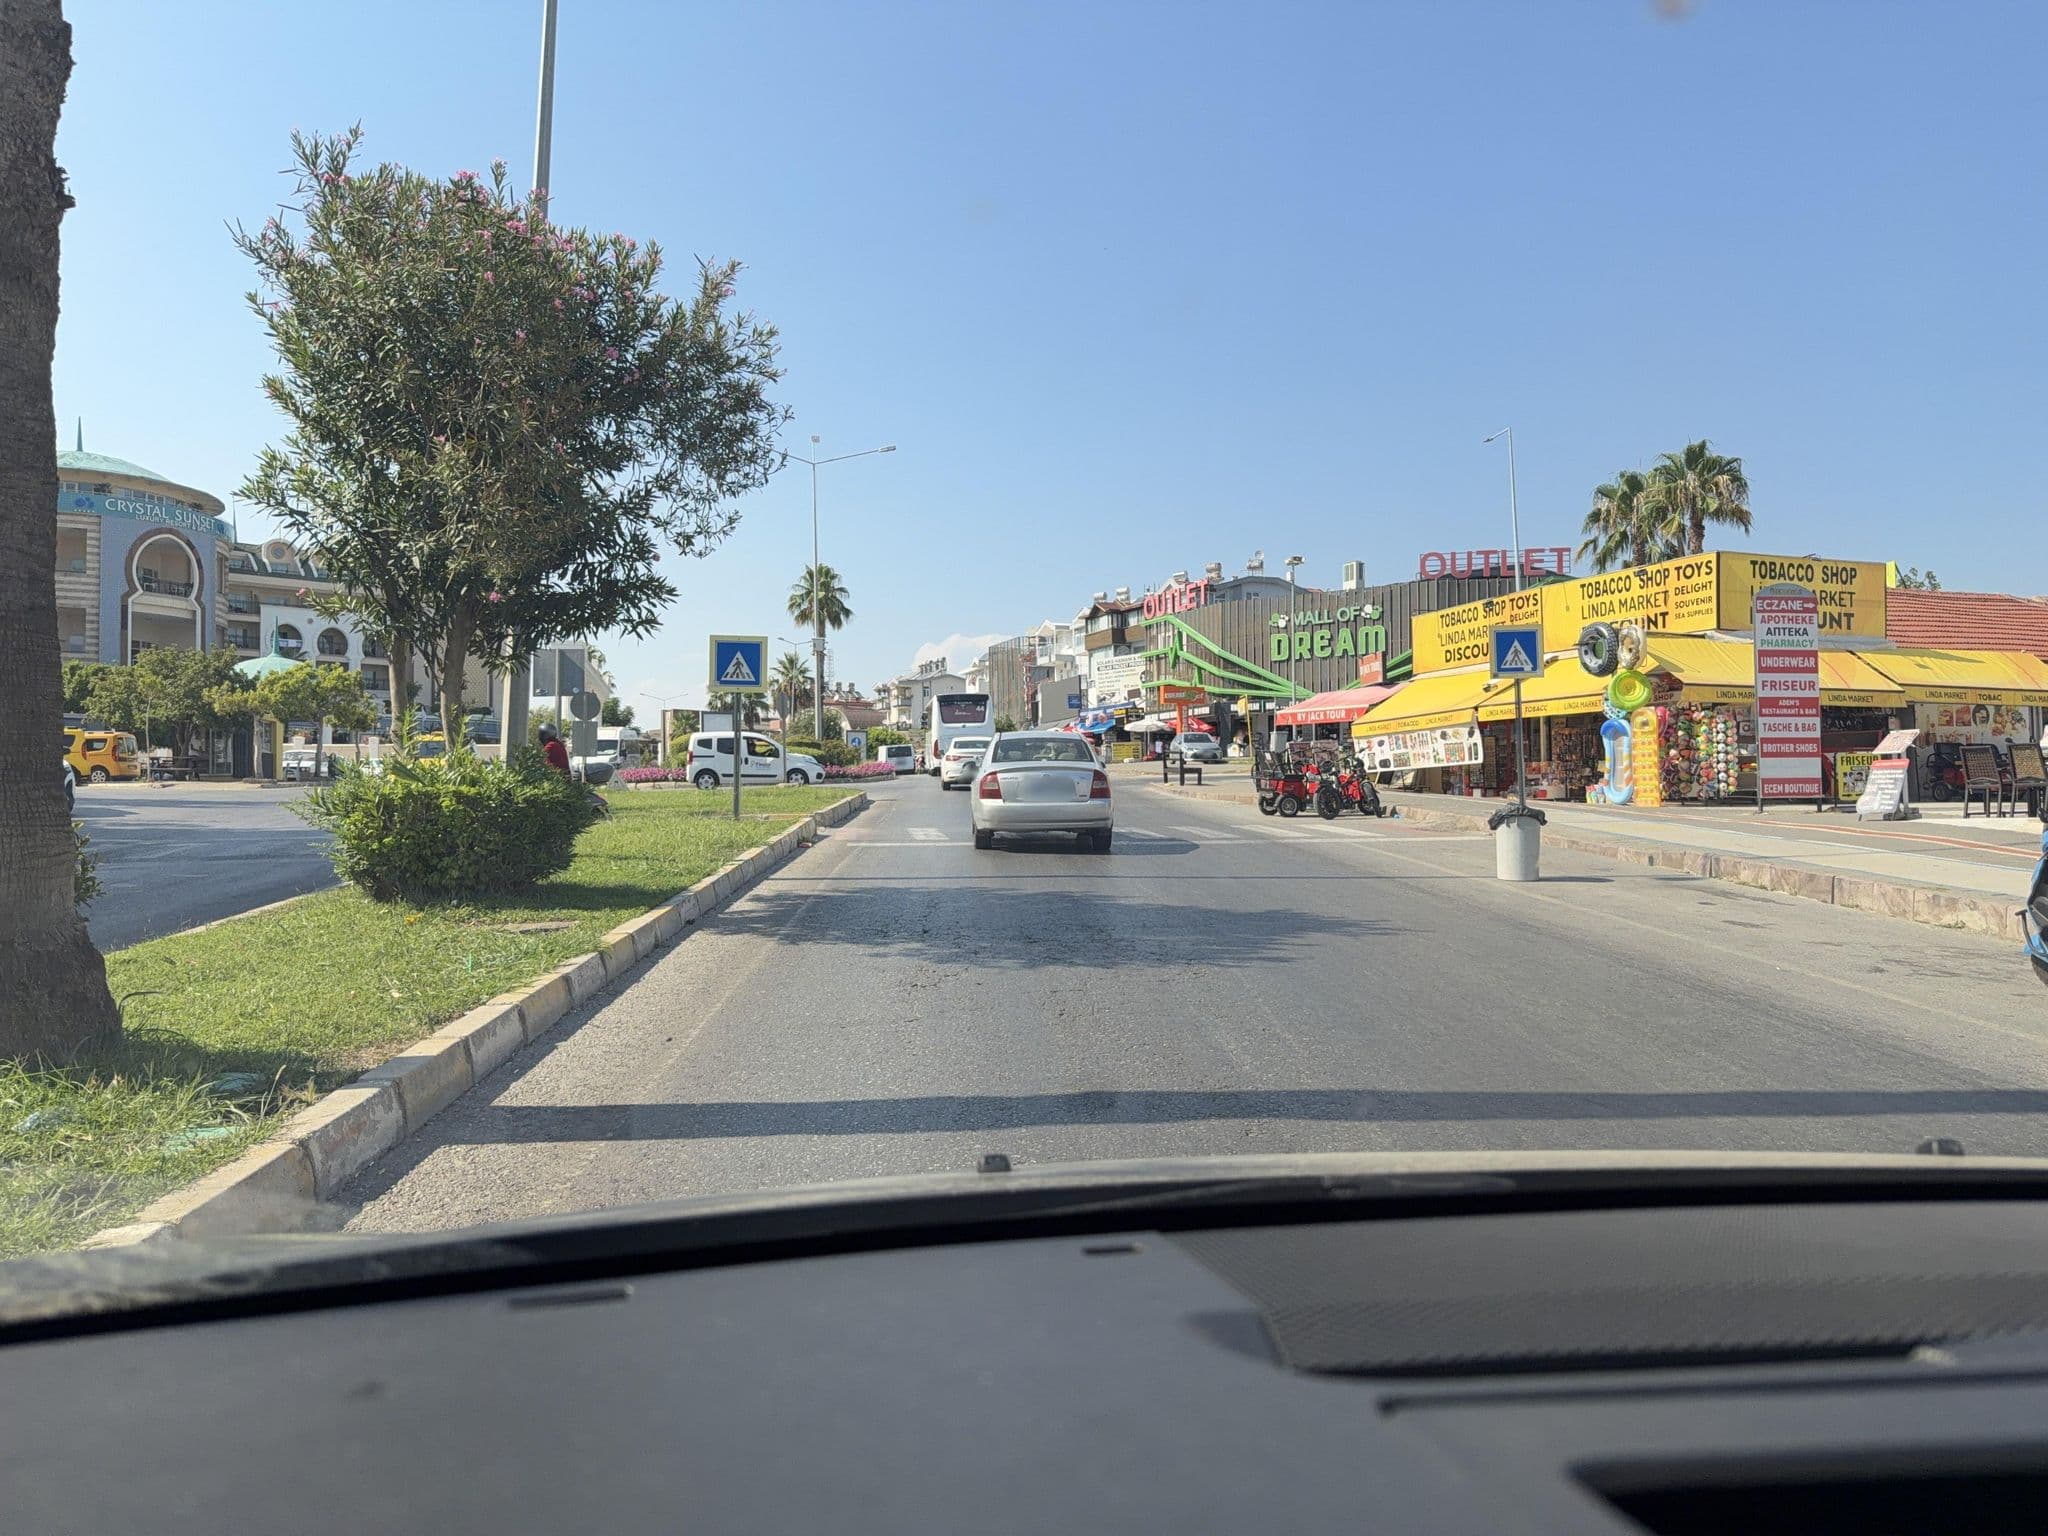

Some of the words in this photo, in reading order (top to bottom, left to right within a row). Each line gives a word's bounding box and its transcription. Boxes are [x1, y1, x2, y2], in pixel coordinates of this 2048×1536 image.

[105, 498, 168, 519] CRYSTAL
[175, 508, 216, 531] SUNSET
[1420, 547, 1571, 580] OUTLET
[1674, 559, 1713, 582] TOYS
[1750, 559, 1814, 583] TOBACCO
[1821, 565, 1857, 586] SHOP
[1580, 574, 1631, 601] TOBACCO
[1638, 567, 1671, 590] SHOP
[1674, 580, 1713, 597] DELIGHT
[1144, 579, 1209, 620] OUTLET
[1509, 592, 1539, 612] TOYS
[1618, 589, 1669, 615] MARKET
[1674, 595, 1713, 610] SOUVENIR
[1756, 600, 1803, 611] ECZANE
[1811, 589, 1857, 608] RKET
[1336, 606, 1360, 622] OF
[1440, 606, 1478, 629] TOBACCO
[1482, 599, 1506, 619] SHOP
[1509, 608, 1539, 623] DELIGHT
[1675, 612, 1686, 620] SEA
[1687, 608, 1713, 618] SUPPLIES
[1760, 614, 1814, 625] APOTHEKE
[1766, 627, 1809, 637] АПТЕКА
[1270, 625, 1386, 662] DREAM
[1760, 639, 1814, 649] PHARMACY
[1445, 642, 1489, 664] DISCOU
[1760, 656, 1816, 668] UNDERWEAR
[1761, 680, 1816, 692] FRISEUR
[1654, 693, 1674, 701] SHOP
[1738, 691, 1755, 700] MAR
[1847, 695, 1874, 703] MARKET
[1943, 691, 1968, 700] MARKET
[1978, 693, 2001, 701] TOBAC
[1308, 711, 1324, 723] JACK
[1326, 710, 1346, 720] TOUR
[1762, 722, 1793, 733] TASCHE
[1794, 723, 1800, 732] &
[1802, 722, 1817, 732] BAG
[1762, 743, 1795, 753] BROTHER
[1796, 743, 1818, 753] SHOES
[1764, 783, 1784, 794] ECEM
[1785, 783, 1819, 793] BOUTIQUE
